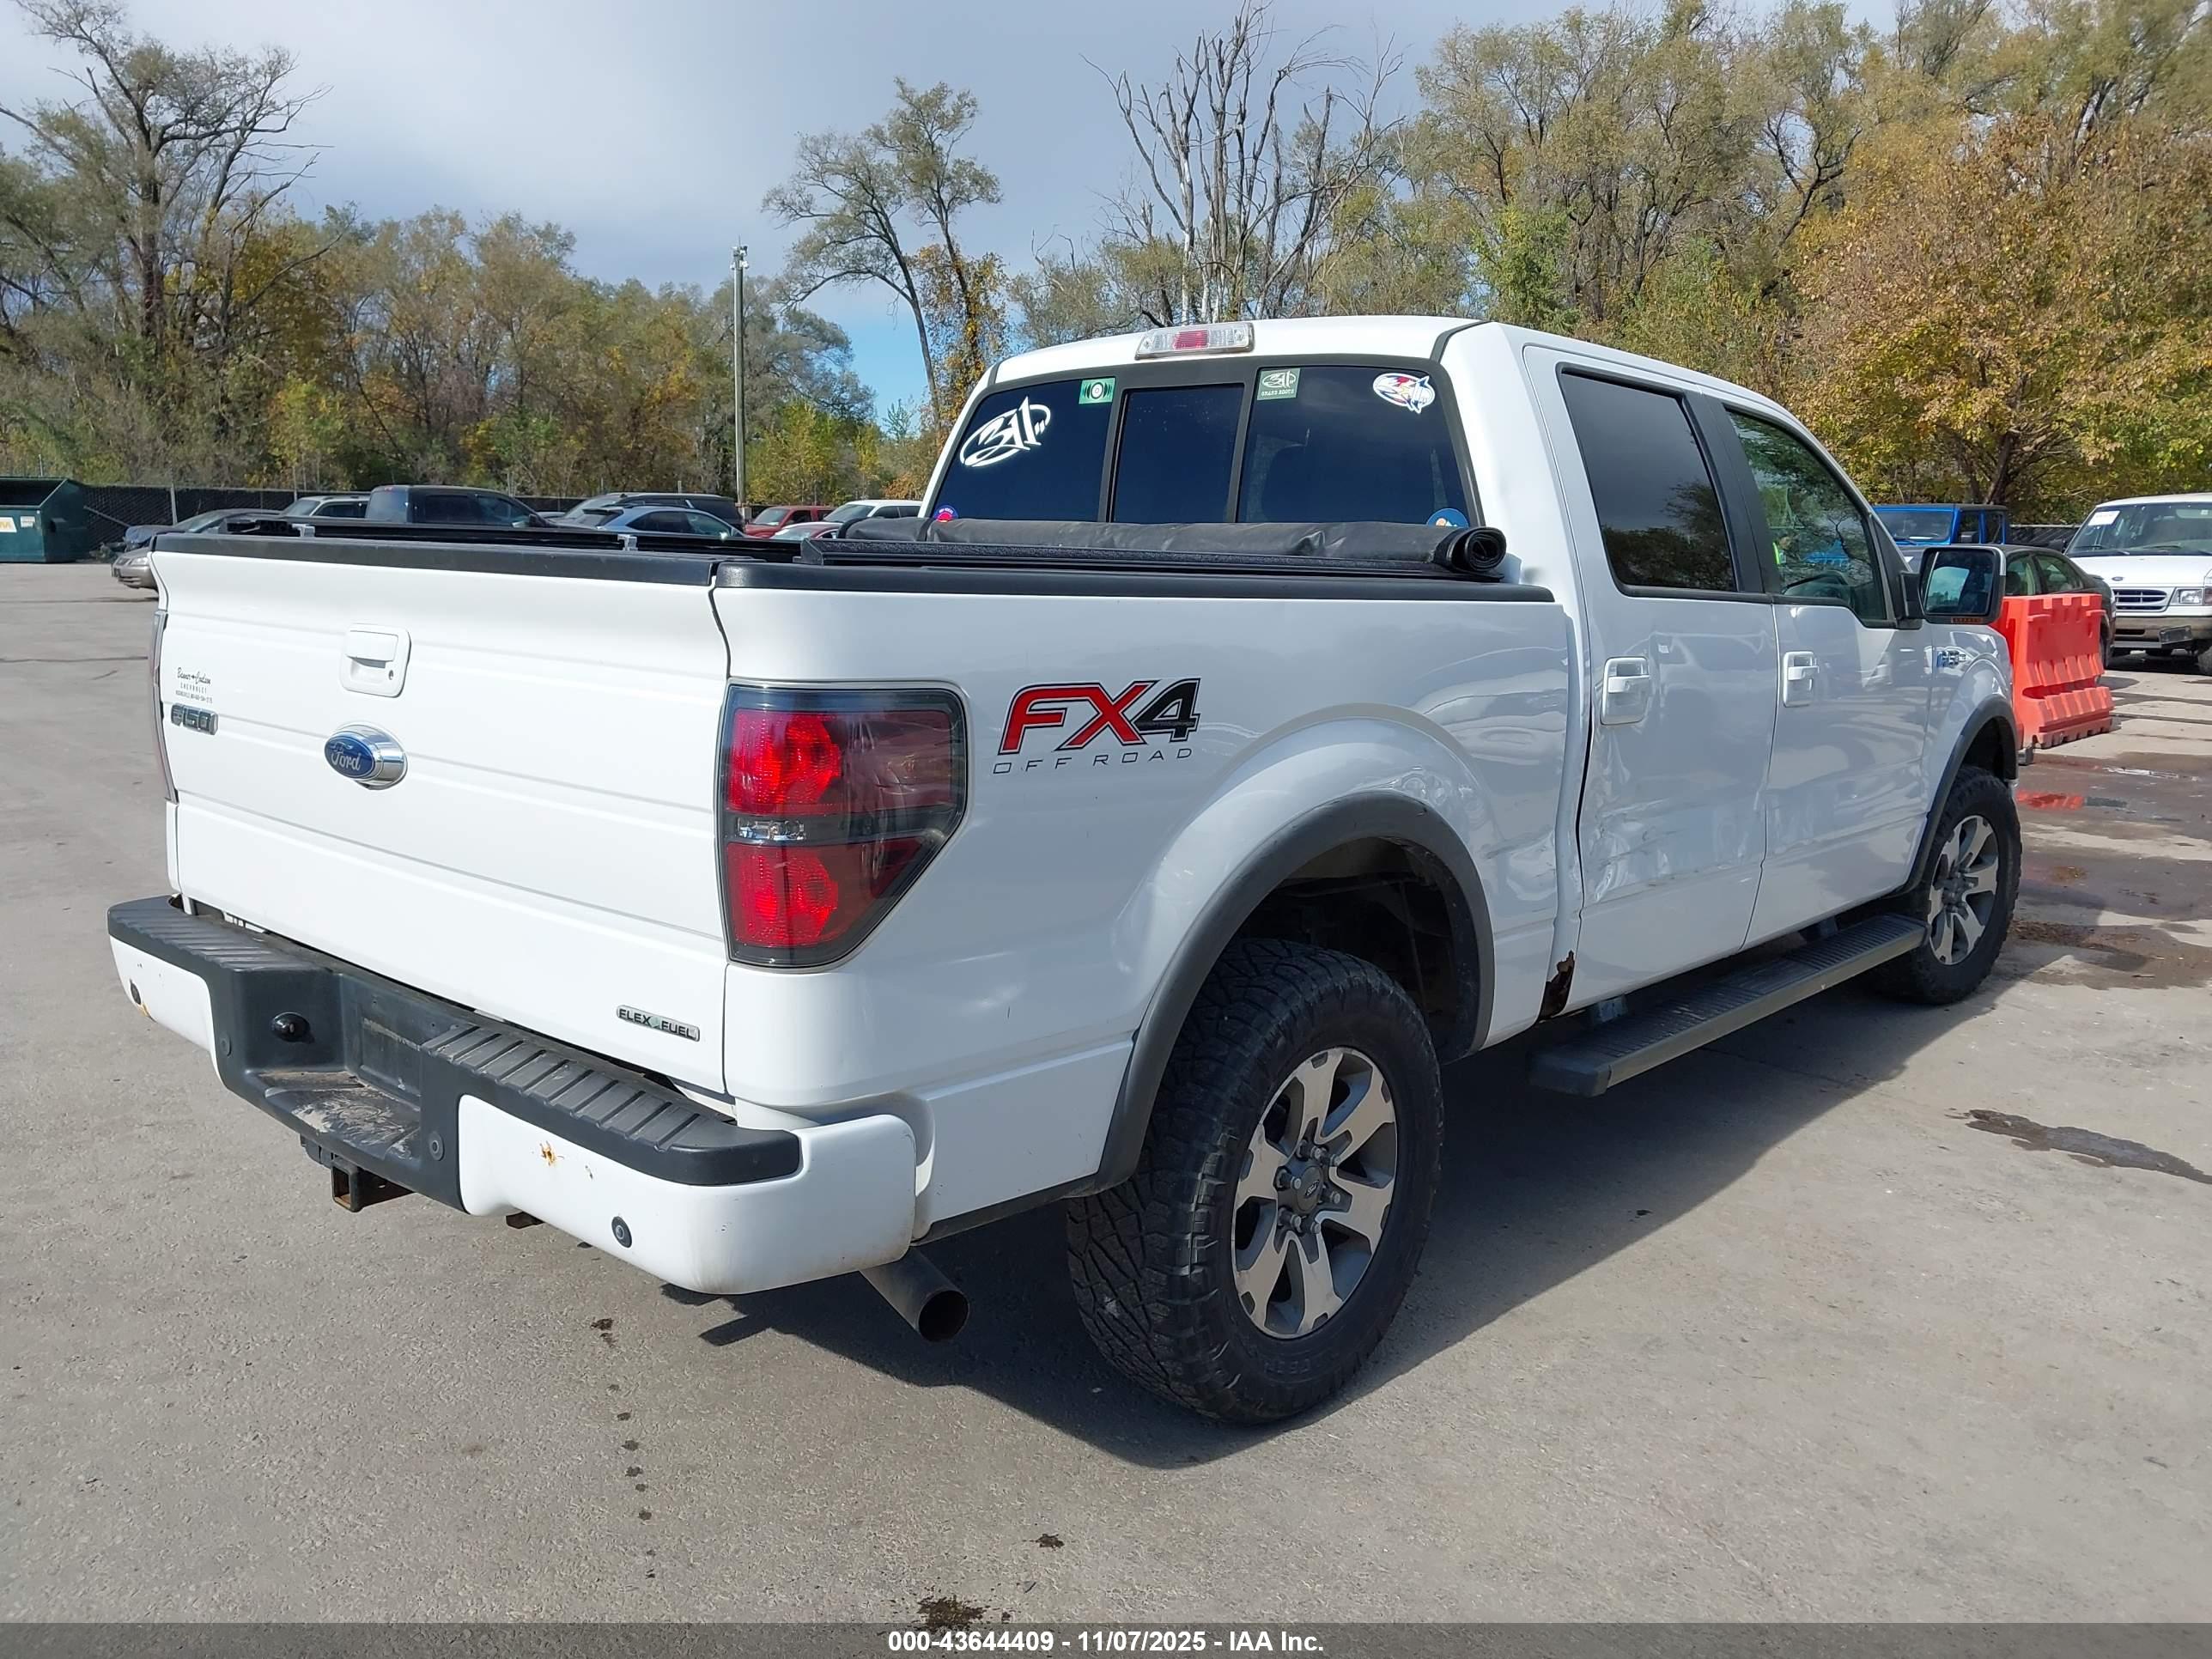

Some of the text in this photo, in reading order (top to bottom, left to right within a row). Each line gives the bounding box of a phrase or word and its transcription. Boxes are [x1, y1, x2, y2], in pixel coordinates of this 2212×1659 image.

[997, 677, 1201, 756] FX4
[331, 742, 362, 771] Ford
[993, 748, 1193, 775] OFF ROAD
